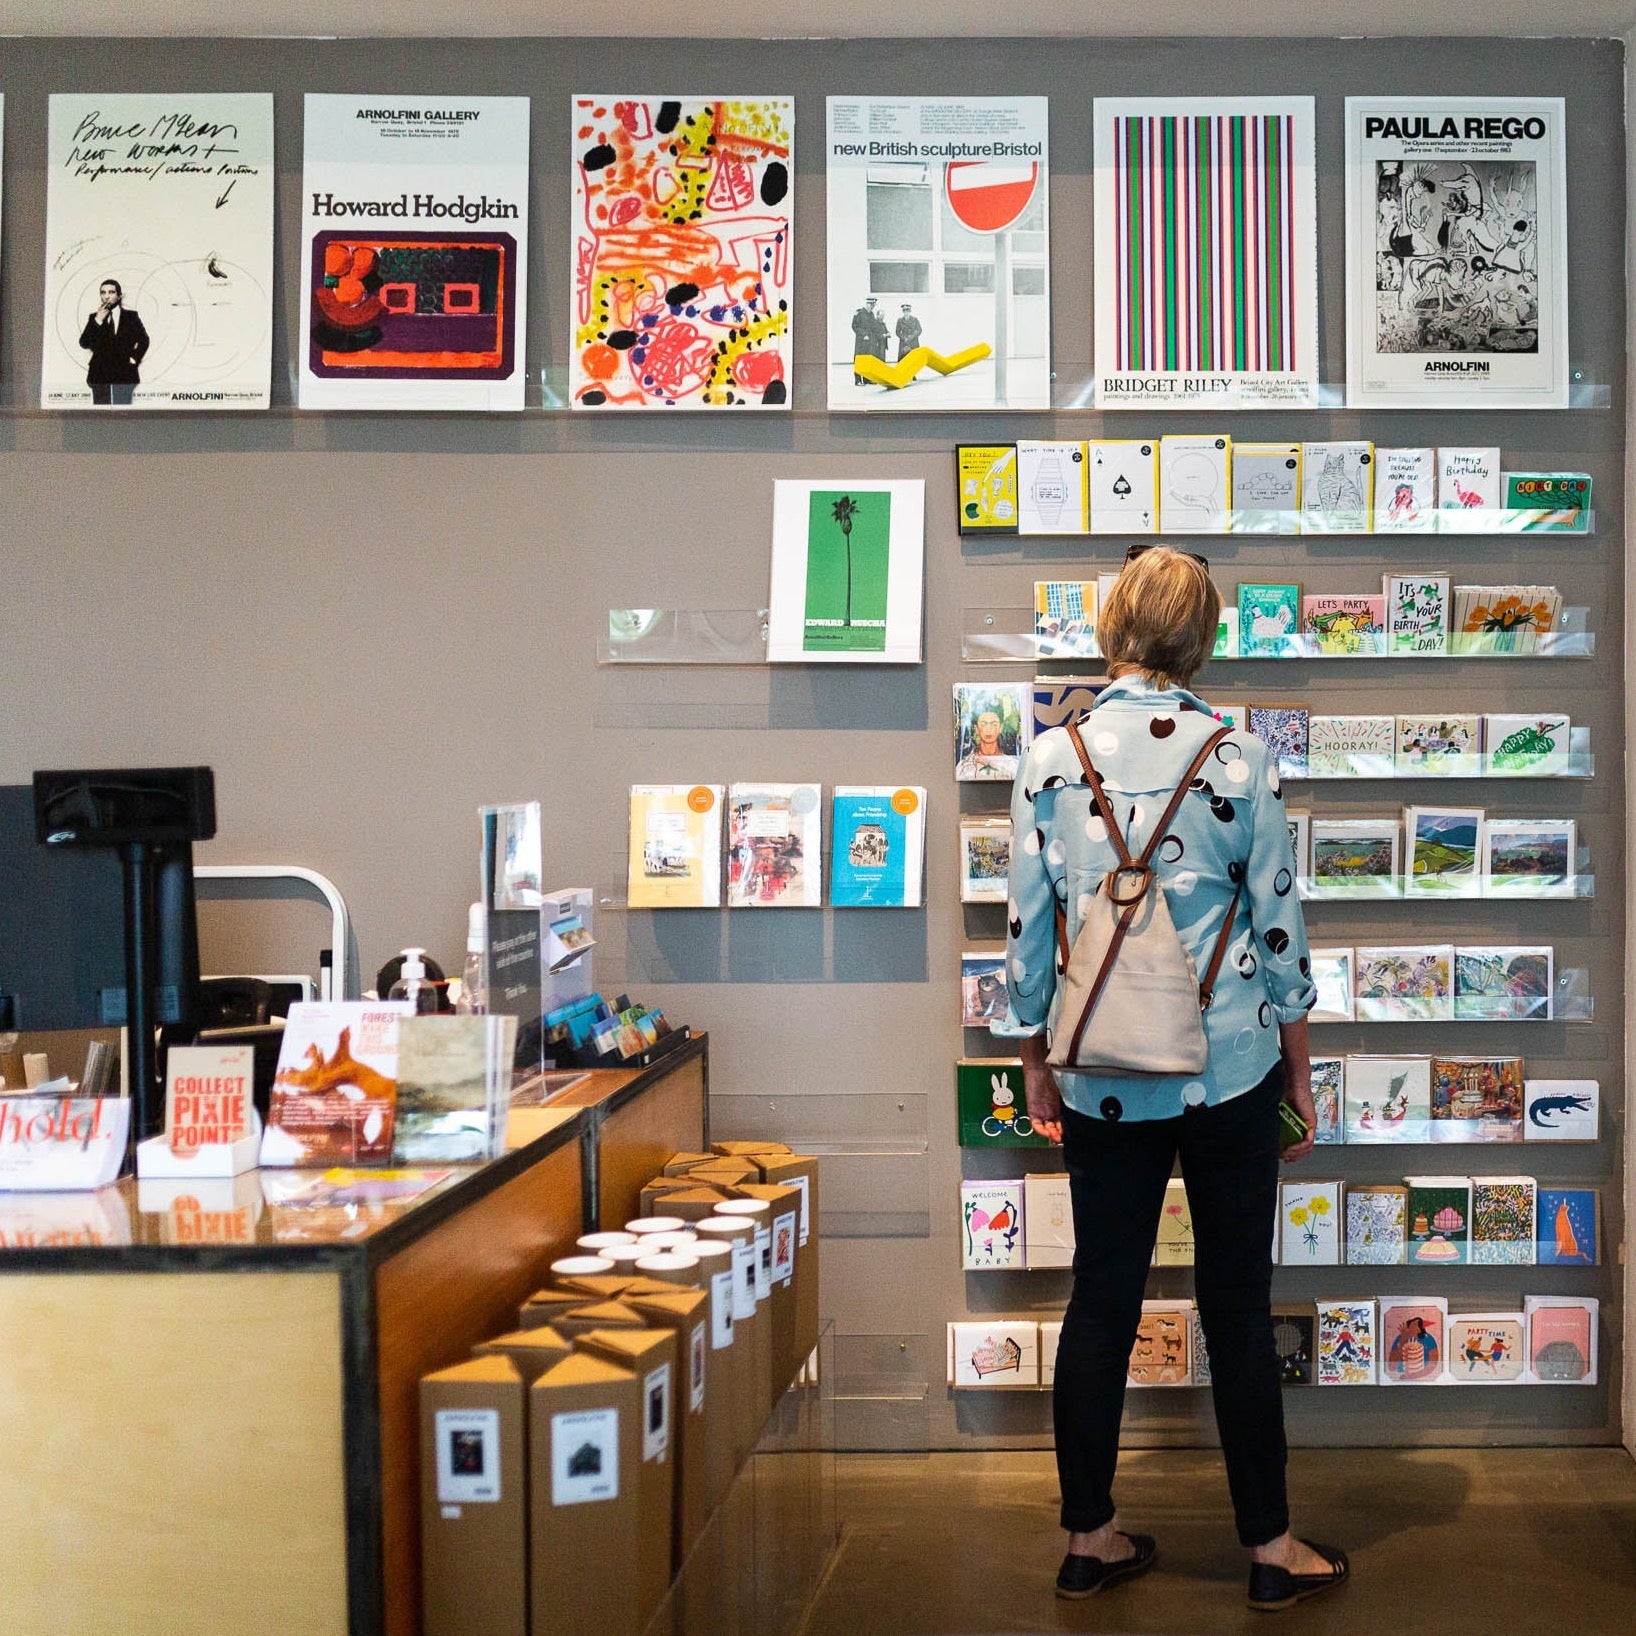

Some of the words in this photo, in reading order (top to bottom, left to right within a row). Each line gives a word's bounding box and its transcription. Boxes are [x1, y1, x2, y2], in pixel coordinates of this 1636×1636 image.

[356, 109, 420, 120] ARNOLFINI
[424, 110, 480, 121] GALLERY
[1366, 117, 1460, 139] PAULA
[1464, 117, 1546, 139] REGO
[834, 143, 866, 156] new
[869, 142, 918, 156] British
[920, 142, 991, 158] sculpture
[993, 142, 1042, 156] Bristol
[312, 193, 408, 217] Howard
[413, 194, 519, 224] Hodgkin
[1424, 361, 1490, 372] ARNOLFINI
[1104, 379, 1178, 392] BRIDGET
[1184, 379, 1232, 392] RILEY
[172, 392, 224, 400] ARNOLFINI
[1446, 464, 1488, 478] Birthday
[1318, 600, 1338, 609] LET'S
[1344, 600, 1370, 609] PARTY
[1416, 604, 1442, 618] YOUR
[1394, 620, 1420, 630] BIRTH
[1324, 742, 1378, 750] HOORAY!
[1497, 728, 1530, 758] HAPPY
[174, 1076, 245, 1095] COLLECT
[174, 1096, 244, 1124] PIXIE
[976, 1258, 1010, 1266] BABY
